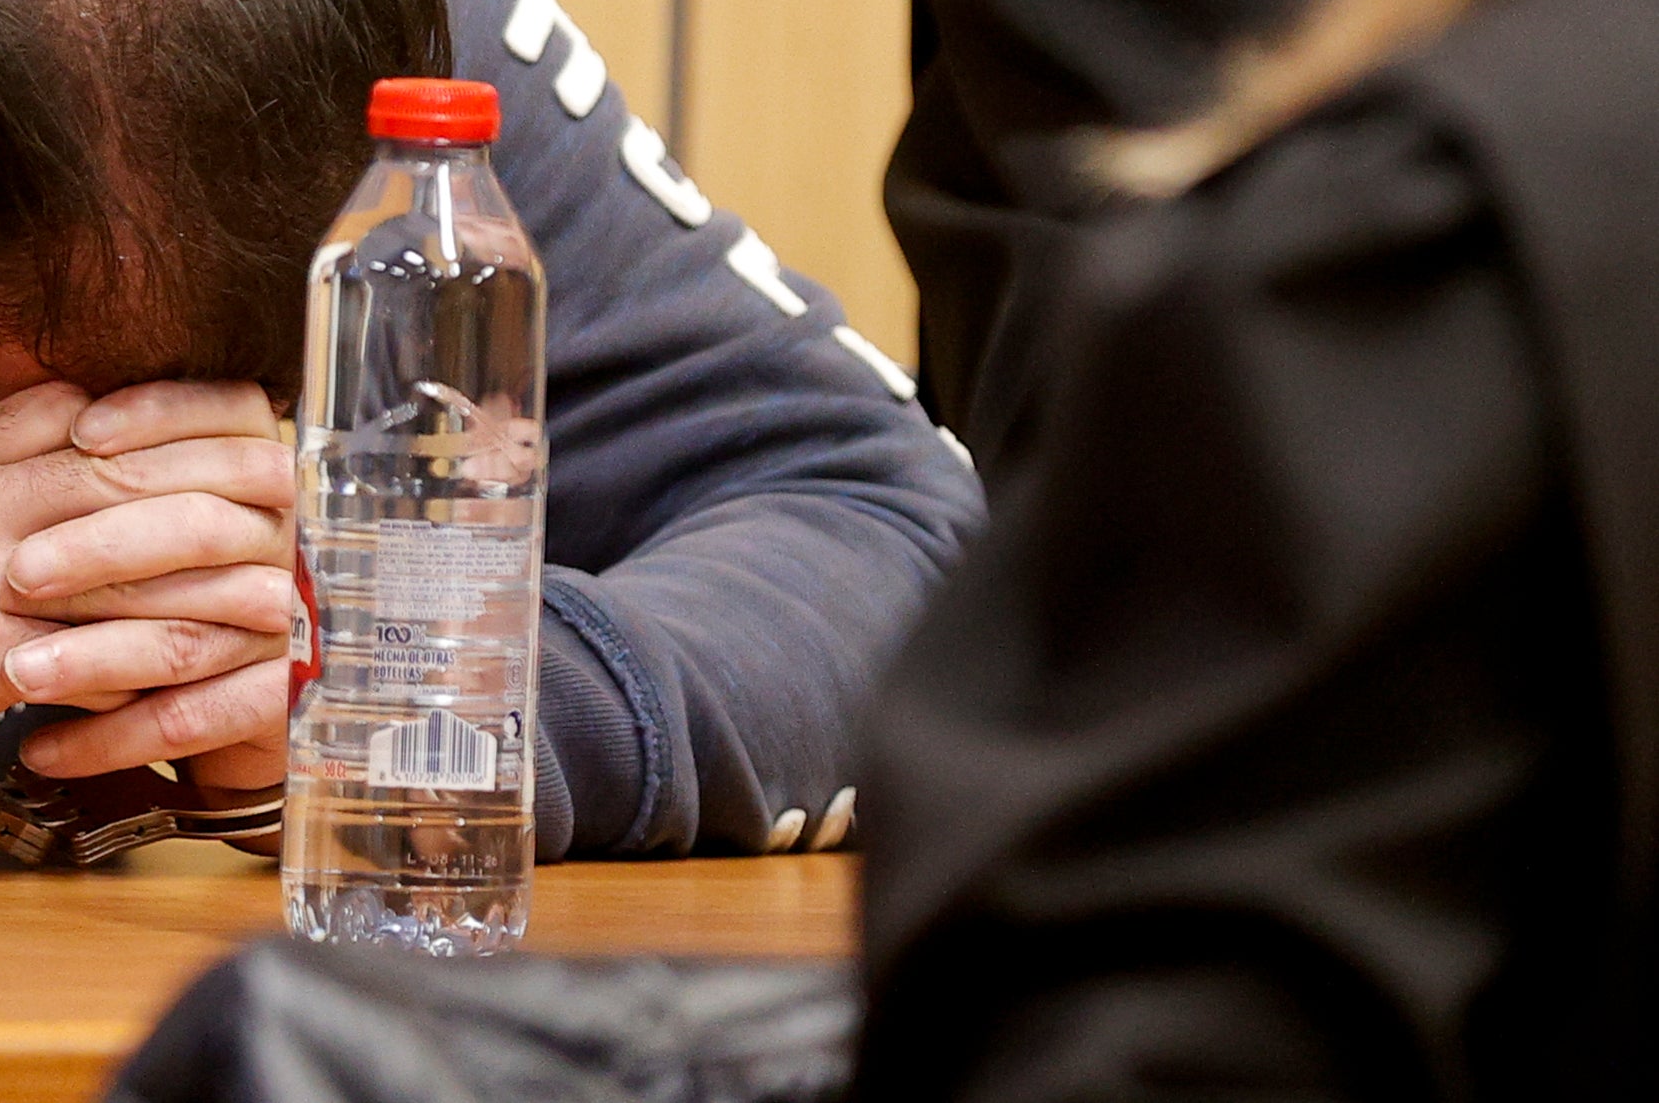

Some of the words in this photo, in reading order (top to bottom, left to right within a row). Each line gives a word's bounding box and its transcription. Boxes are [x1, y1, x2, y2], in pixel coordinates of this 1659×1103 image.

[374, 649, 405, 662] HECHA
[408, 650, 419, 663] DE
[423, 651, 454, 665] OTRAS
[374, 666, 422, 678] BOTELLAS
